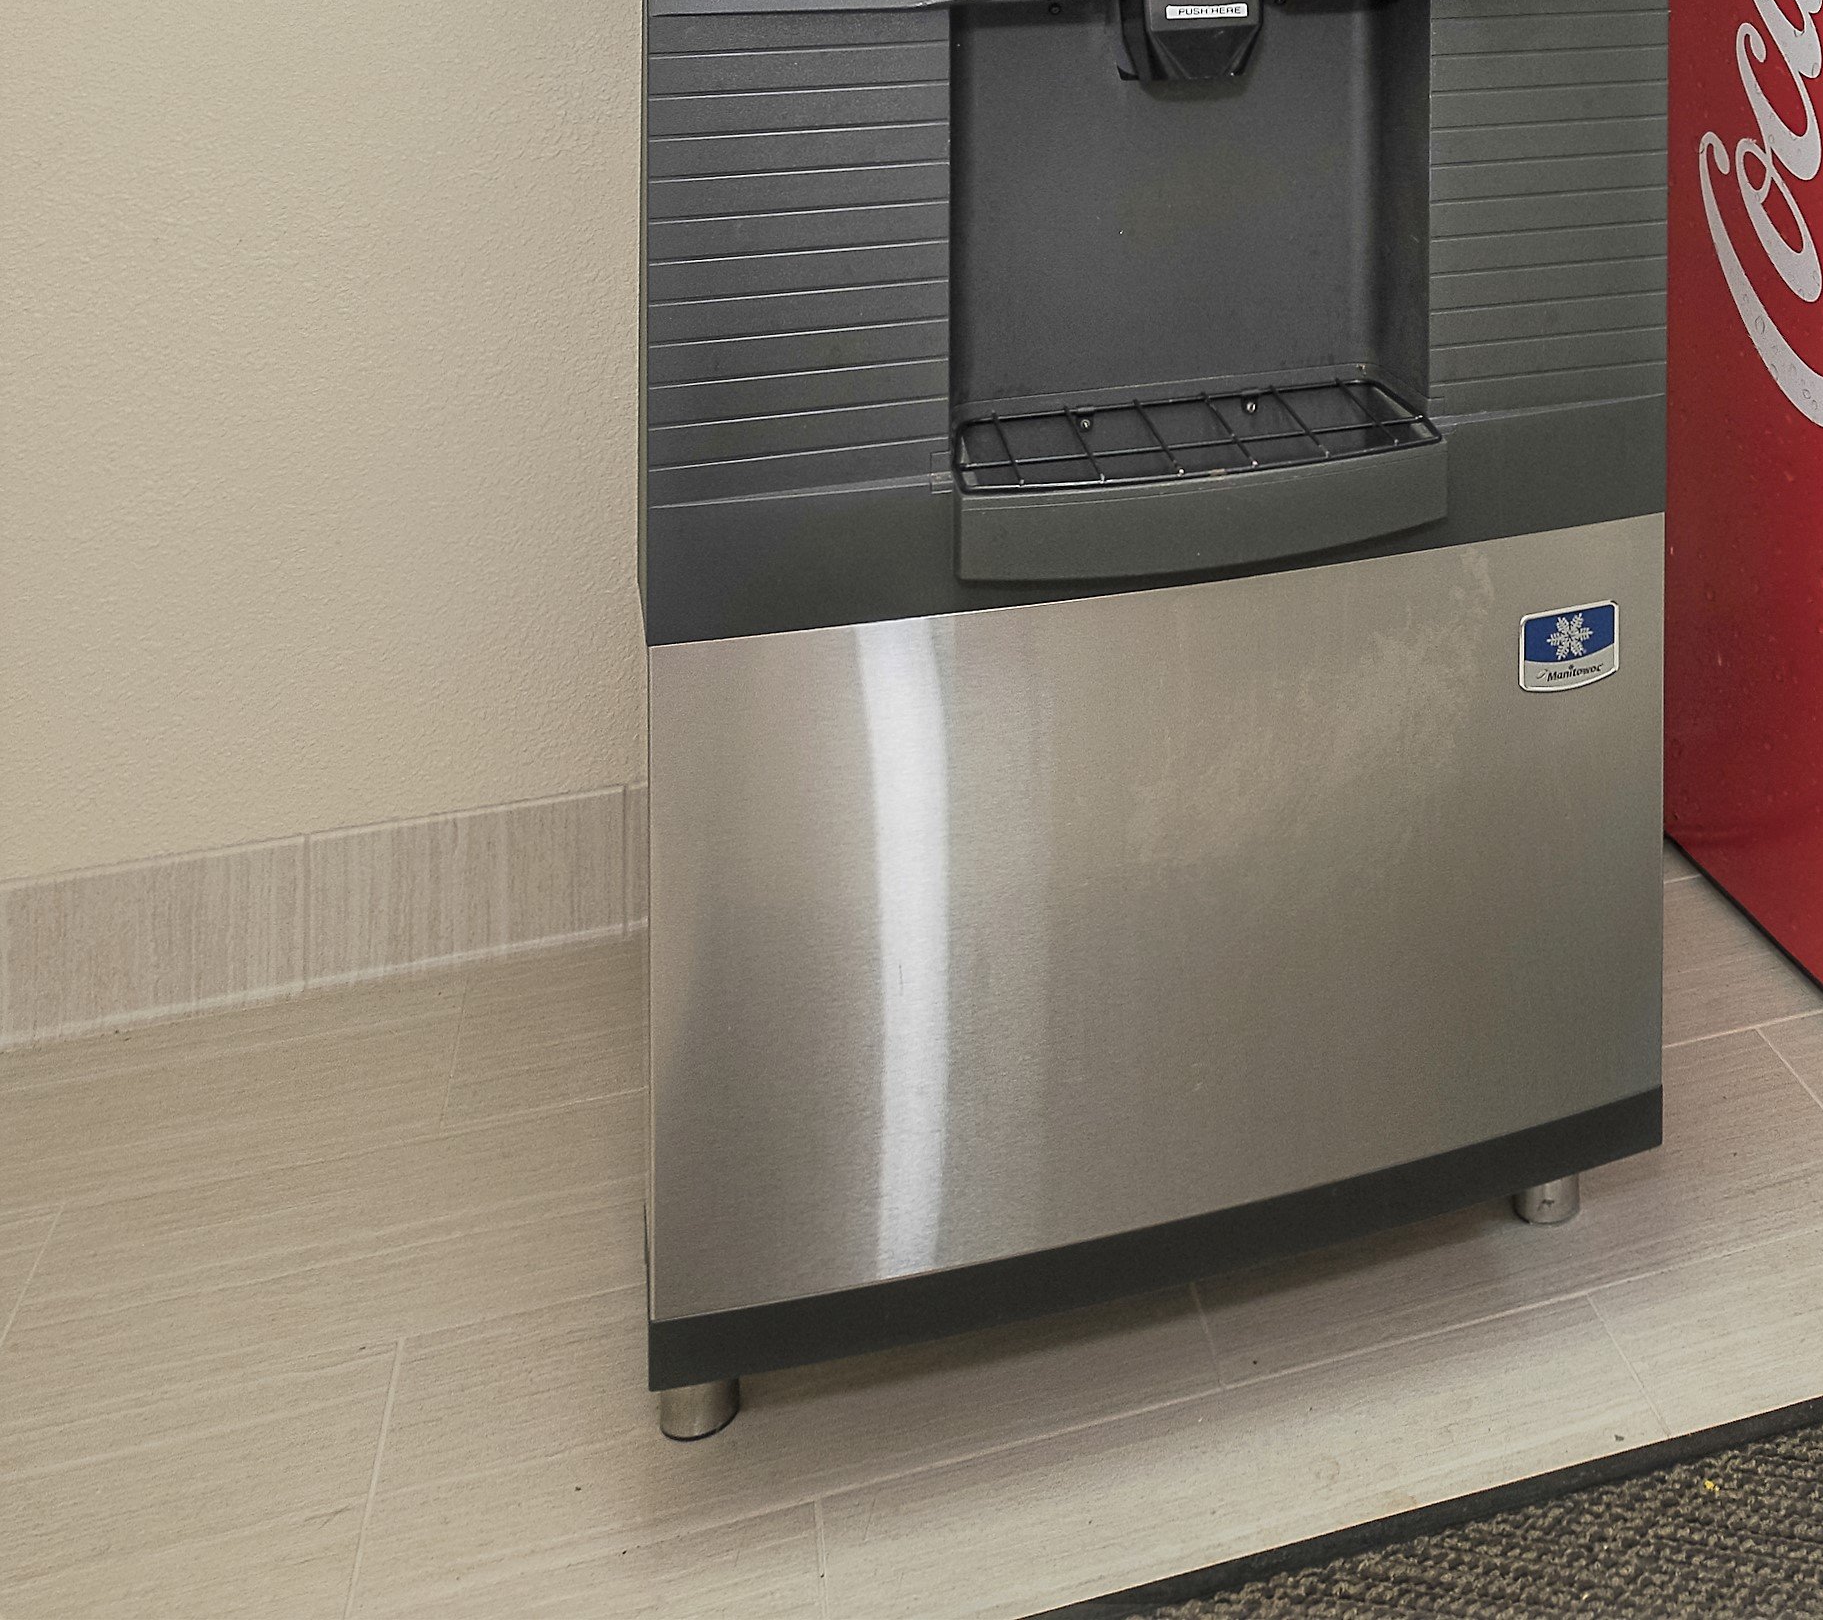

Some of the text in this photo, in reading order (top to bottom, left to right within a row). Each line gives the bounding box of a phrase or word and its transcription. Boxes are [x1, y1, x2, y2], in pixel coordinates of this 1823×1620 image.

[1178, 6, 1241, 16] PUSH HERE
[1547, 663, 1604, 682] Manitowoc
